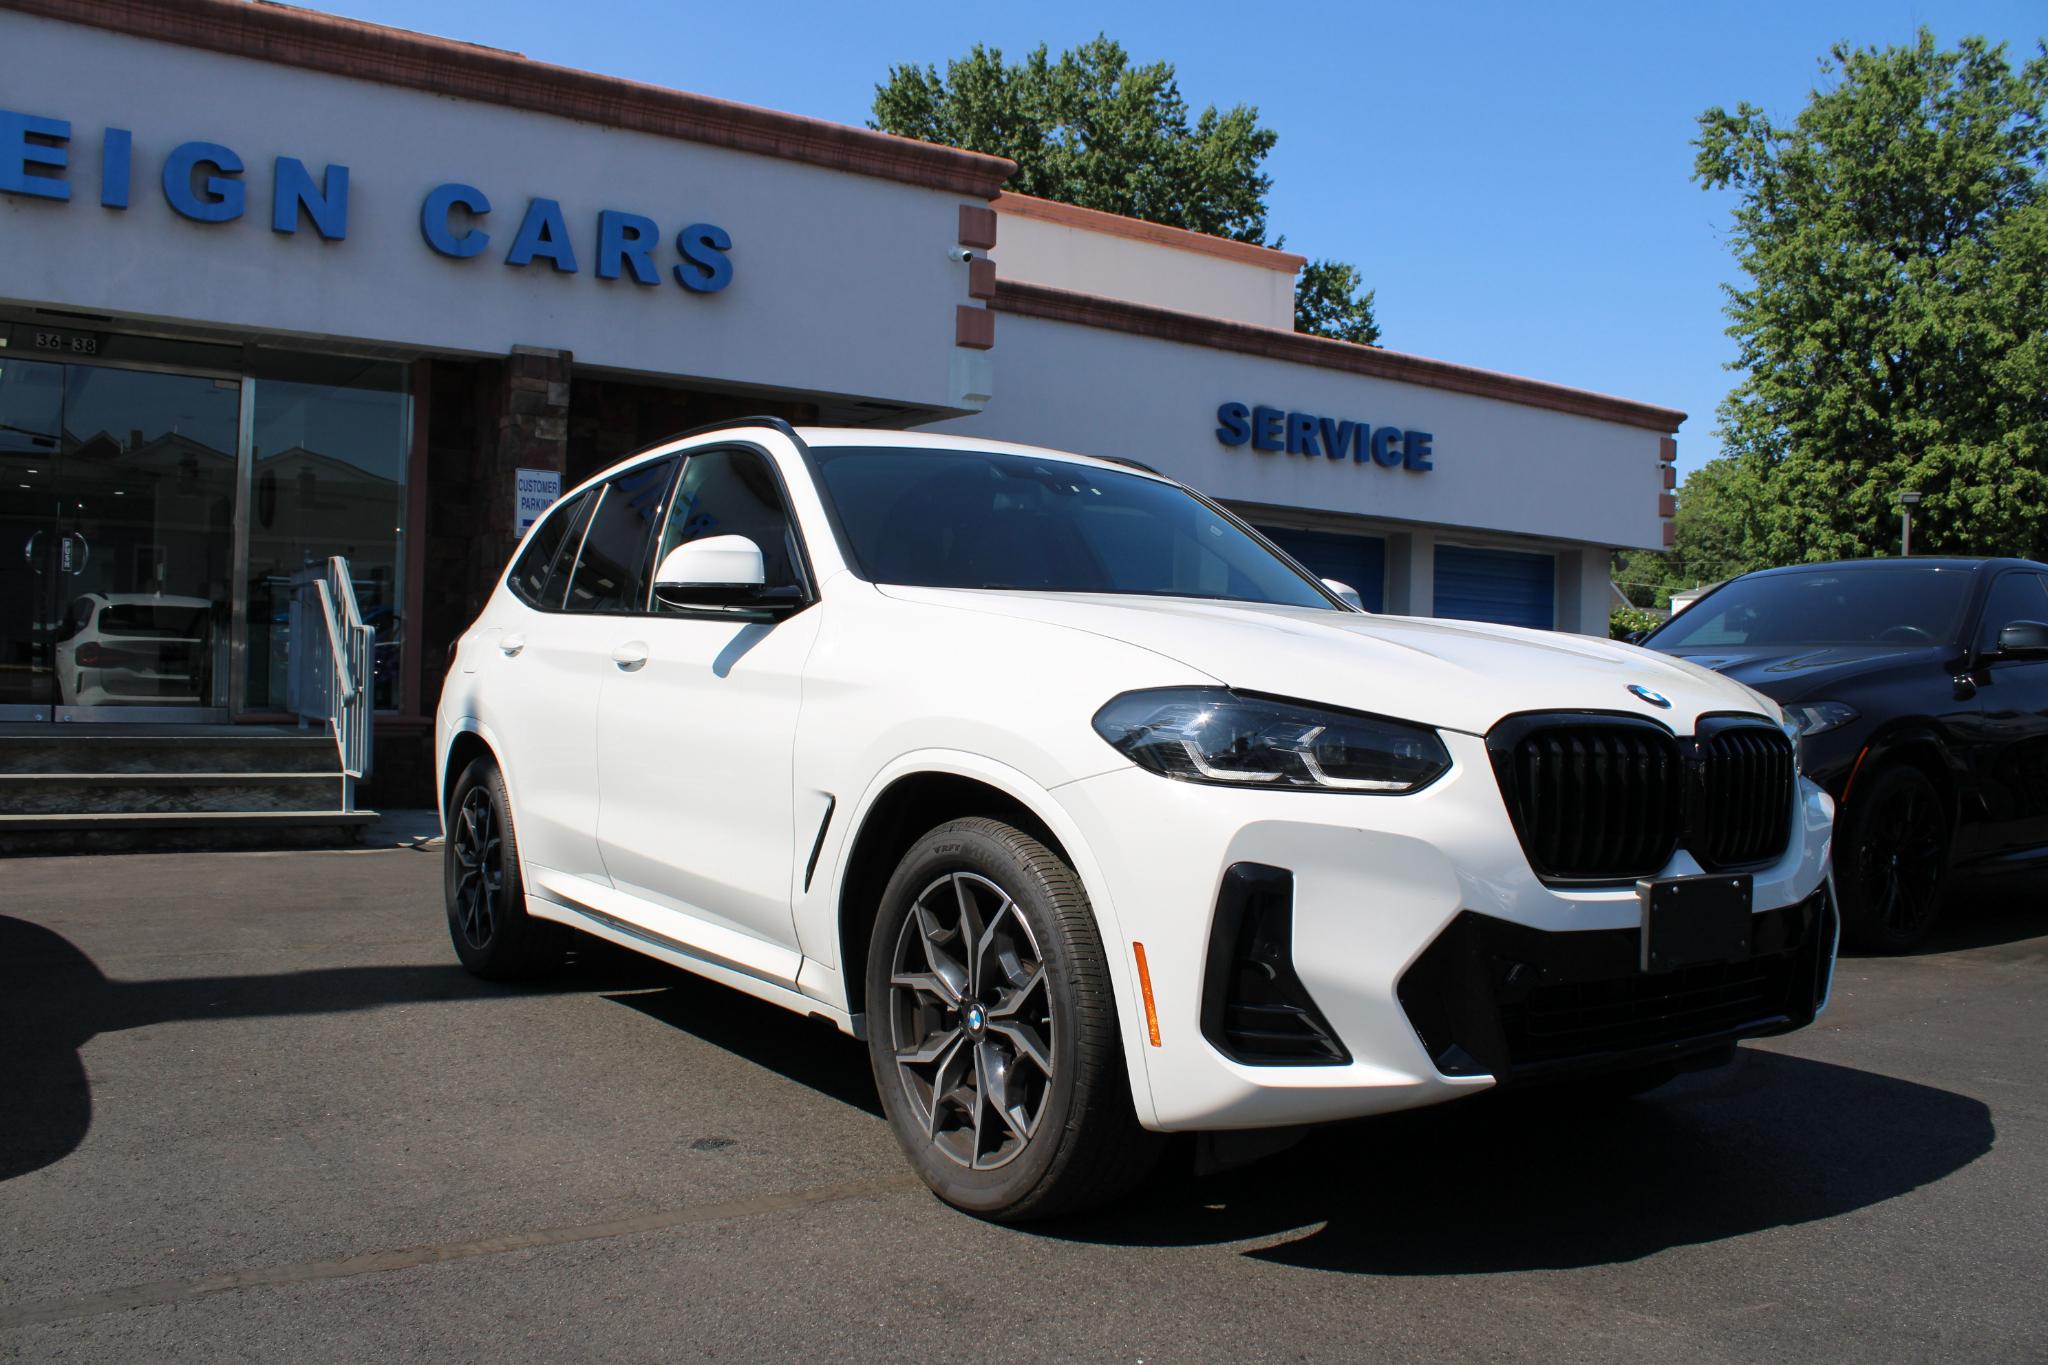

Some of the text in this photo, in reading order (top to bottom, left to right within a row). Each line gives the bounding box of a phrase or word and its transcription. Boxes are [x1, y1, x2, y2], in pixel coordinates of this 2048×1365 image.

[0, 109, 733, 293] EIGN CARS
[1216, 402, 1433, 472] SERVICE
[519, 479, 558, 494] CUSTOMER
